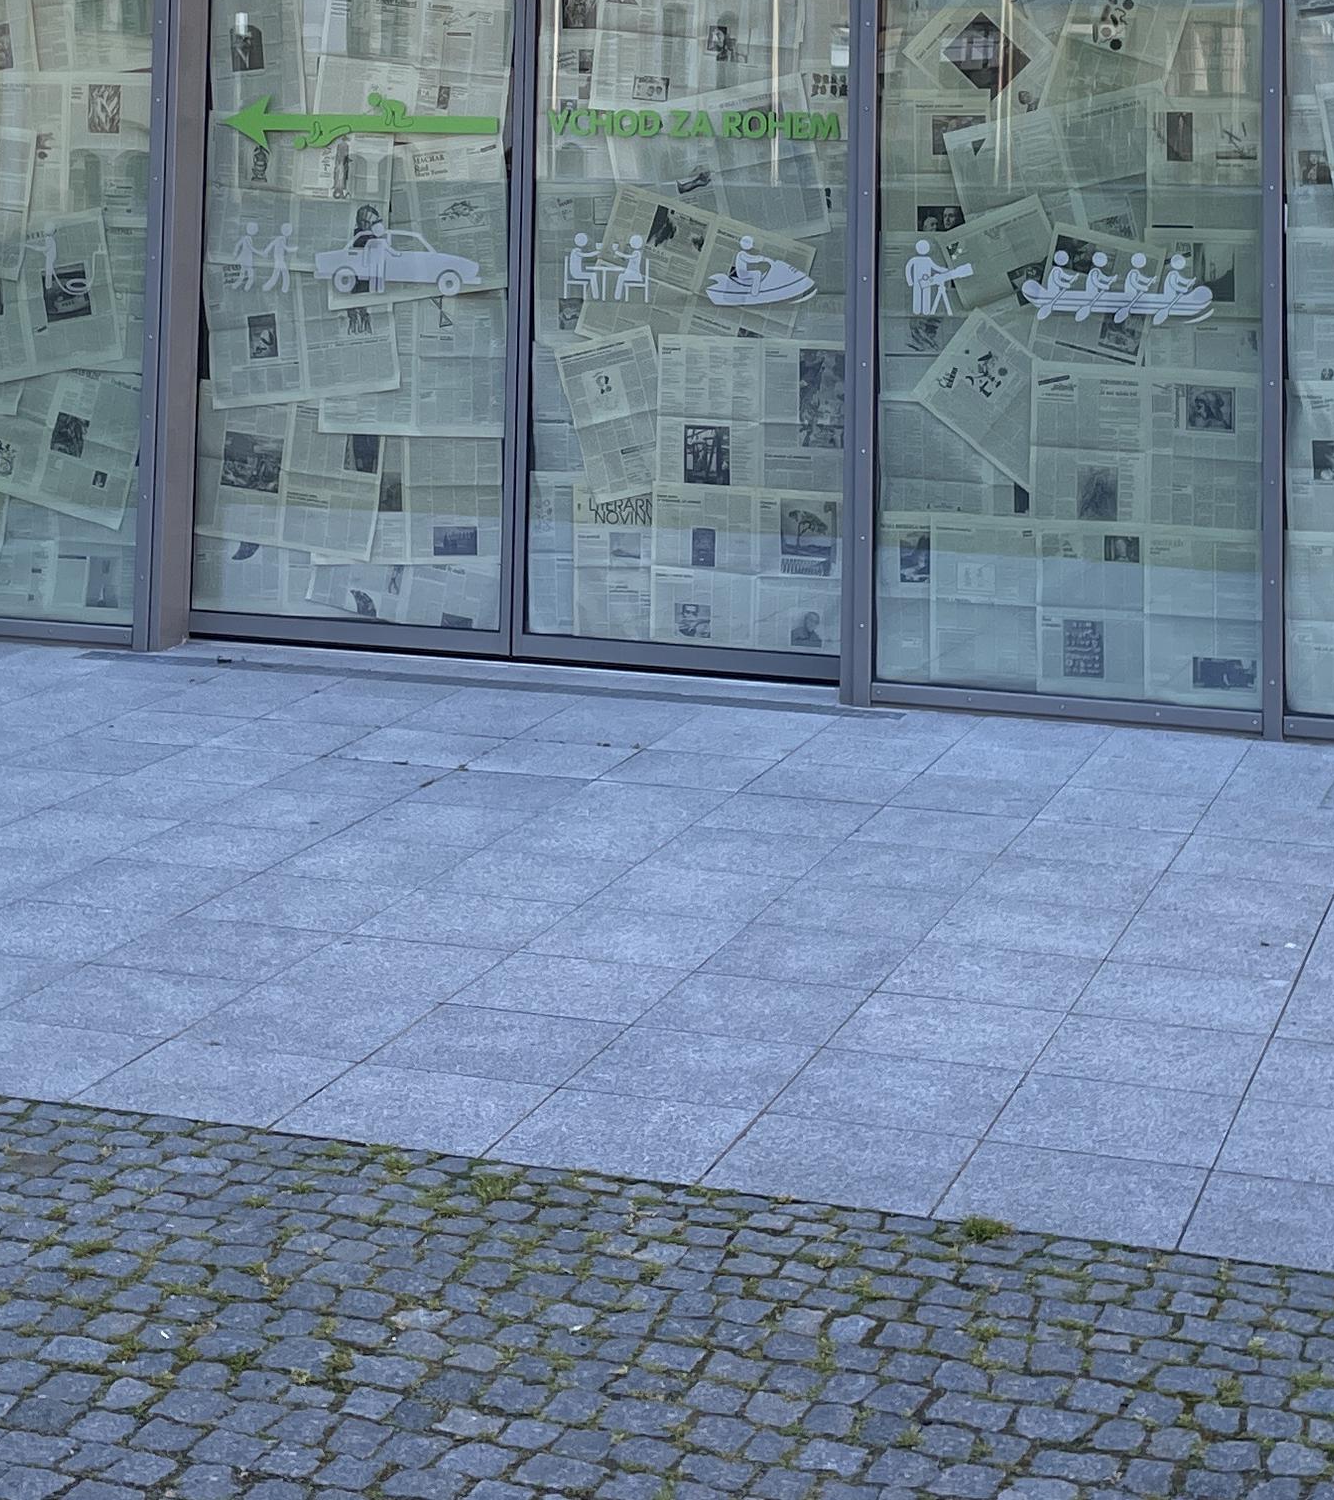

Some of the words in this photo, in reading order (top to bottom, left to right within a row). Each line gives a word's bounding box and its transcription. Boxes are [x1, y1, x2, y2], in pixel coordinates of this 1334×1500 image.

[547, 108, 663, 137] VCHOD
[668, 109, 715, 138] ZA
[722, 110, 843, 141] ROHEM
